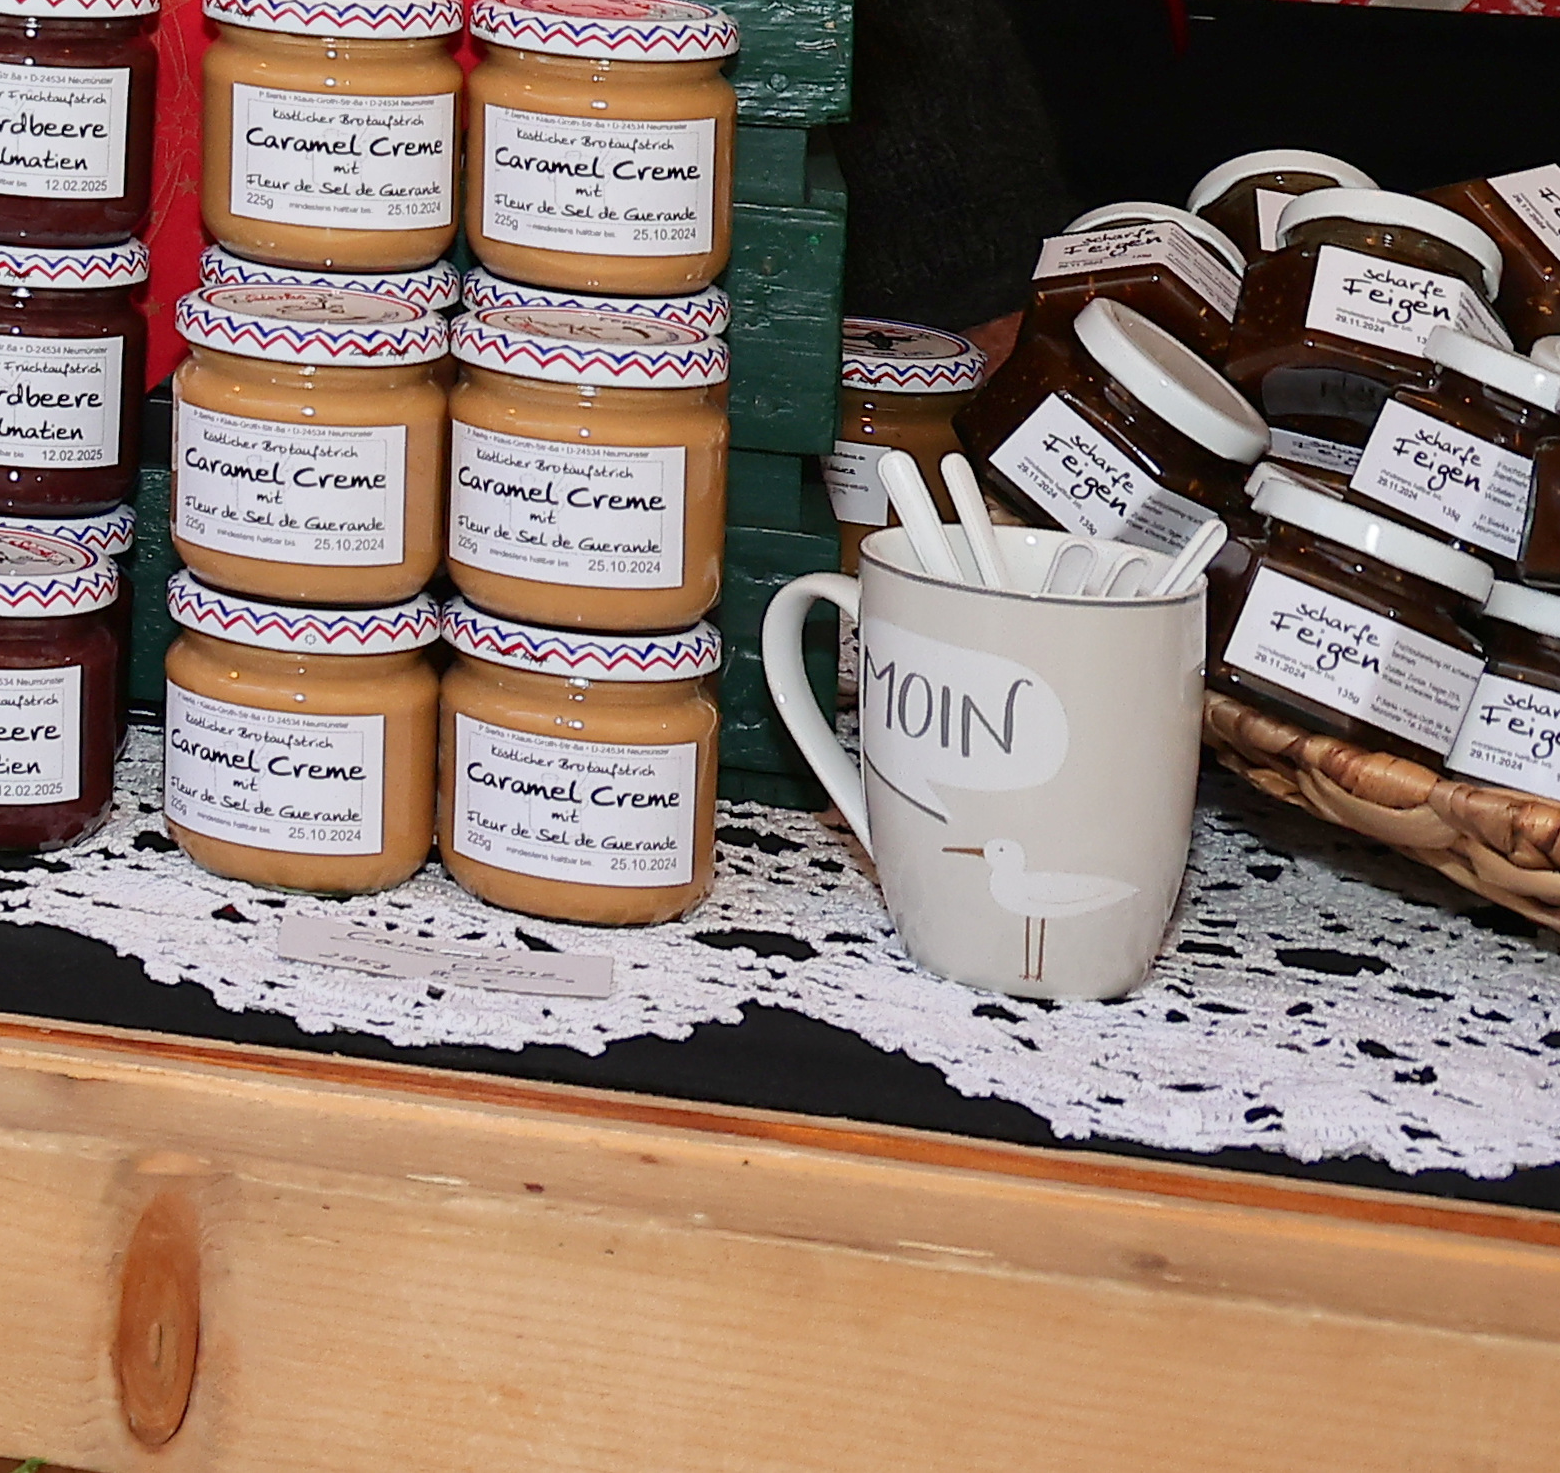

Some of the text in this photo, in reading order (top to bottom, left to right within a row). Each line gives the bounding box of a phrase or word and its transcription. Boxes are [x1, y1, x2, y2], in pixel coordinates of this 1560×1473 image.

[246, 126, 444, 158] Caramel Creme
[494, 146, 701, 182] Caramel Creme
[293, 181, 314, 194] de
[320, 179, 349, 196] Sel
[353, 183, 377, 196] de
[334, 161, 360, 175] mit
[387, 201, 441, 216] 25.10.2024
[1342, 275, 1451, 324] Feigen
[1362, 267, 1447, 299] scharfe
[185, 446, 387, 492] Caramel Creme
[1069, 431, 1137, 496] scharfe
[1392, 433, 1482, 494] Feigen
[1413, 426, 1483, 468] scharfe
[457, 464, 667, 513] Caramel Creme
[1042, 433, 1129, 518] Feigen
[1270, 610, 1380, 674] Feigen
[1295, 603, 1380, 648] scharfe
[1254, 651, 1306, 680] 29.11.2024
[863, 649, 1035, 760] MOIN
[1336, 686, 1361, 705] 135g
[466, 762, 680, 810] Caramel Creme
